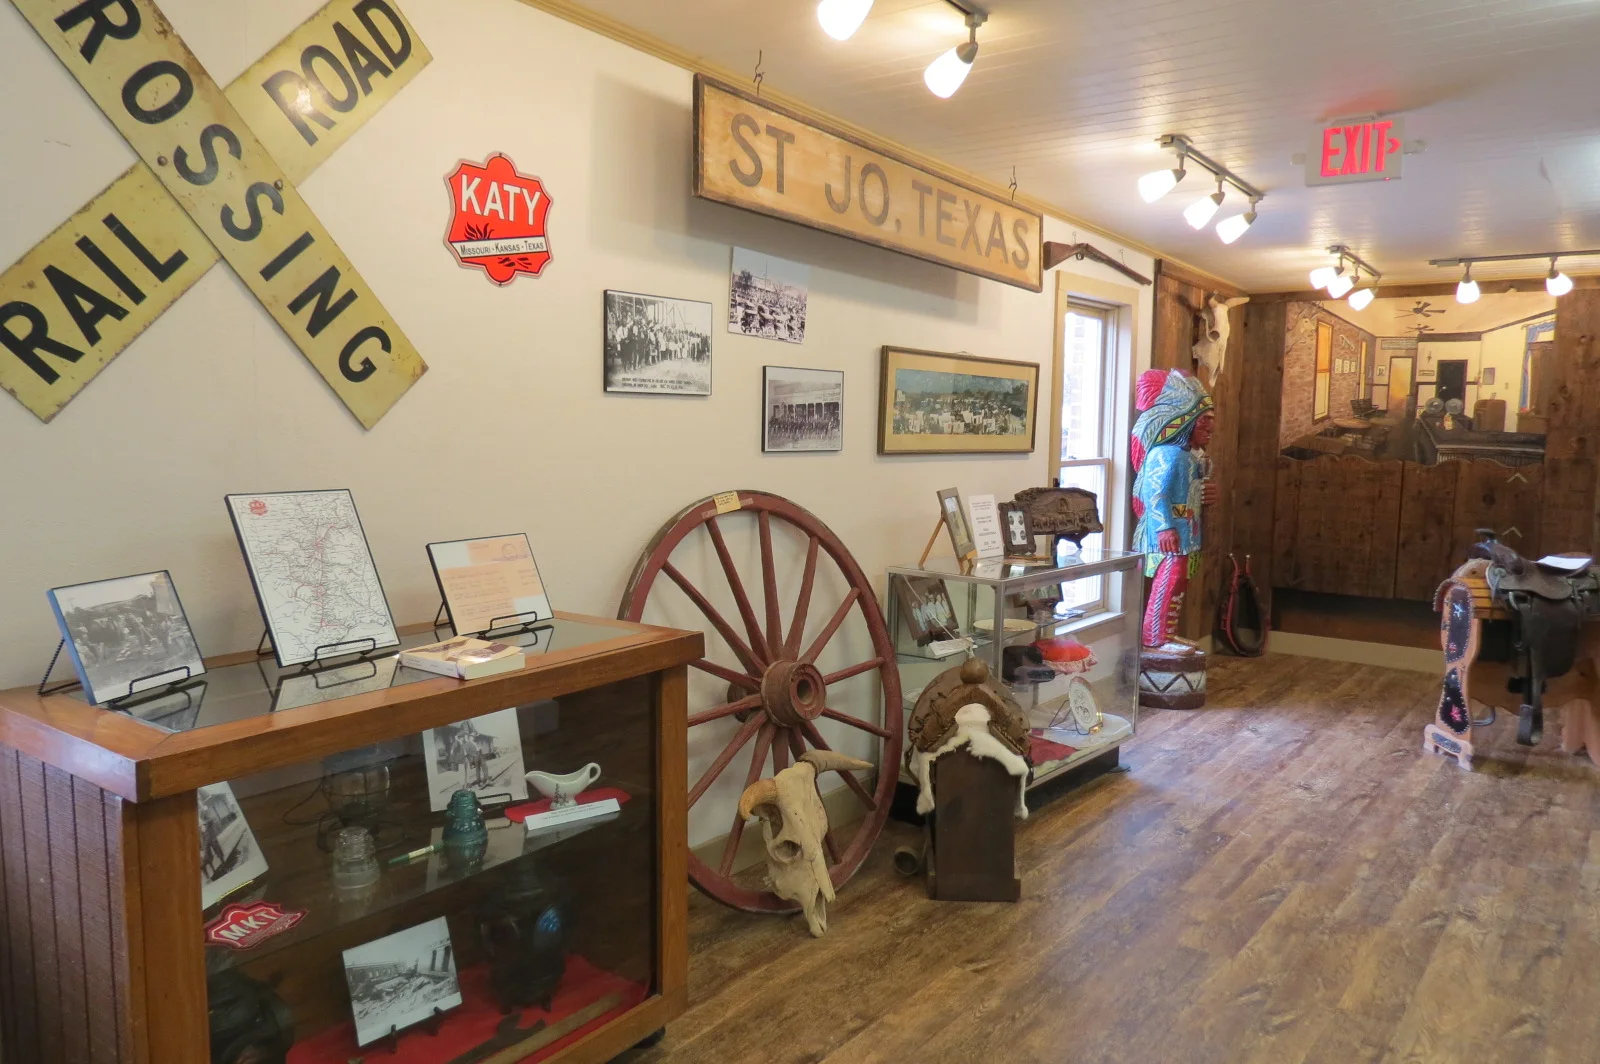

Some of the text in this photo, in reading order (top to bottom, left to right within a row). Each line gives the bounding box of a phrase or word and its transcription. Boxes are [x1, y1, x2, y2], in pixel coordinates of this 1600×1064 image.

[261, 0, 412, 147] ROAD
[461, 174, 541, 226] KATY
[729, 113, 795, 195] ST
[912, 179, 1030, 270] TEXAS
[1320, 120, 1392, 177] EXIT
[0, 213, 189, 386] RAIL
